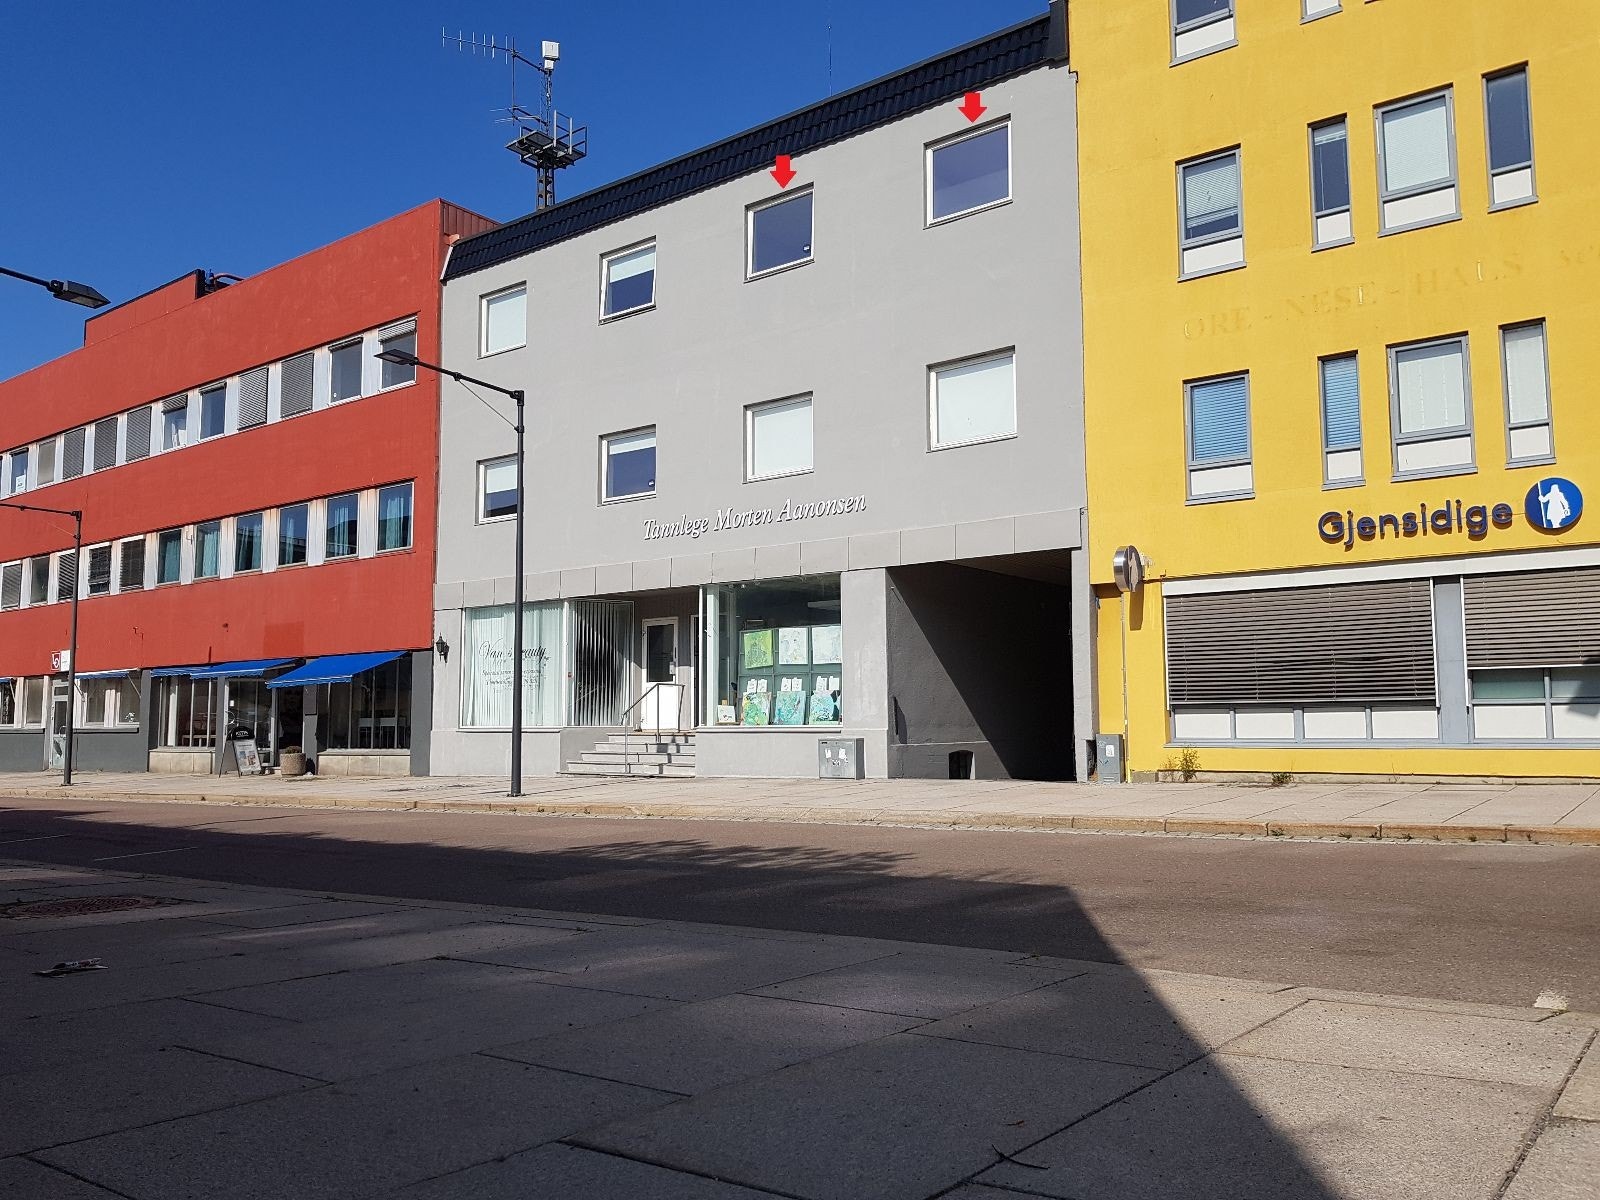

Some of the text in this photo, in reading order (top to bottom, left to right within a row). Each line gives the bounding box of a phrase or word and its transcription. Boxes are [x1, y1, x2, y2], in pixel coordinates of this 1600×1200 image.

[642, 494, 867, 540] Tannlege Morten Aanonsen
[1318, 499, 1514, 549] Gjensidige
